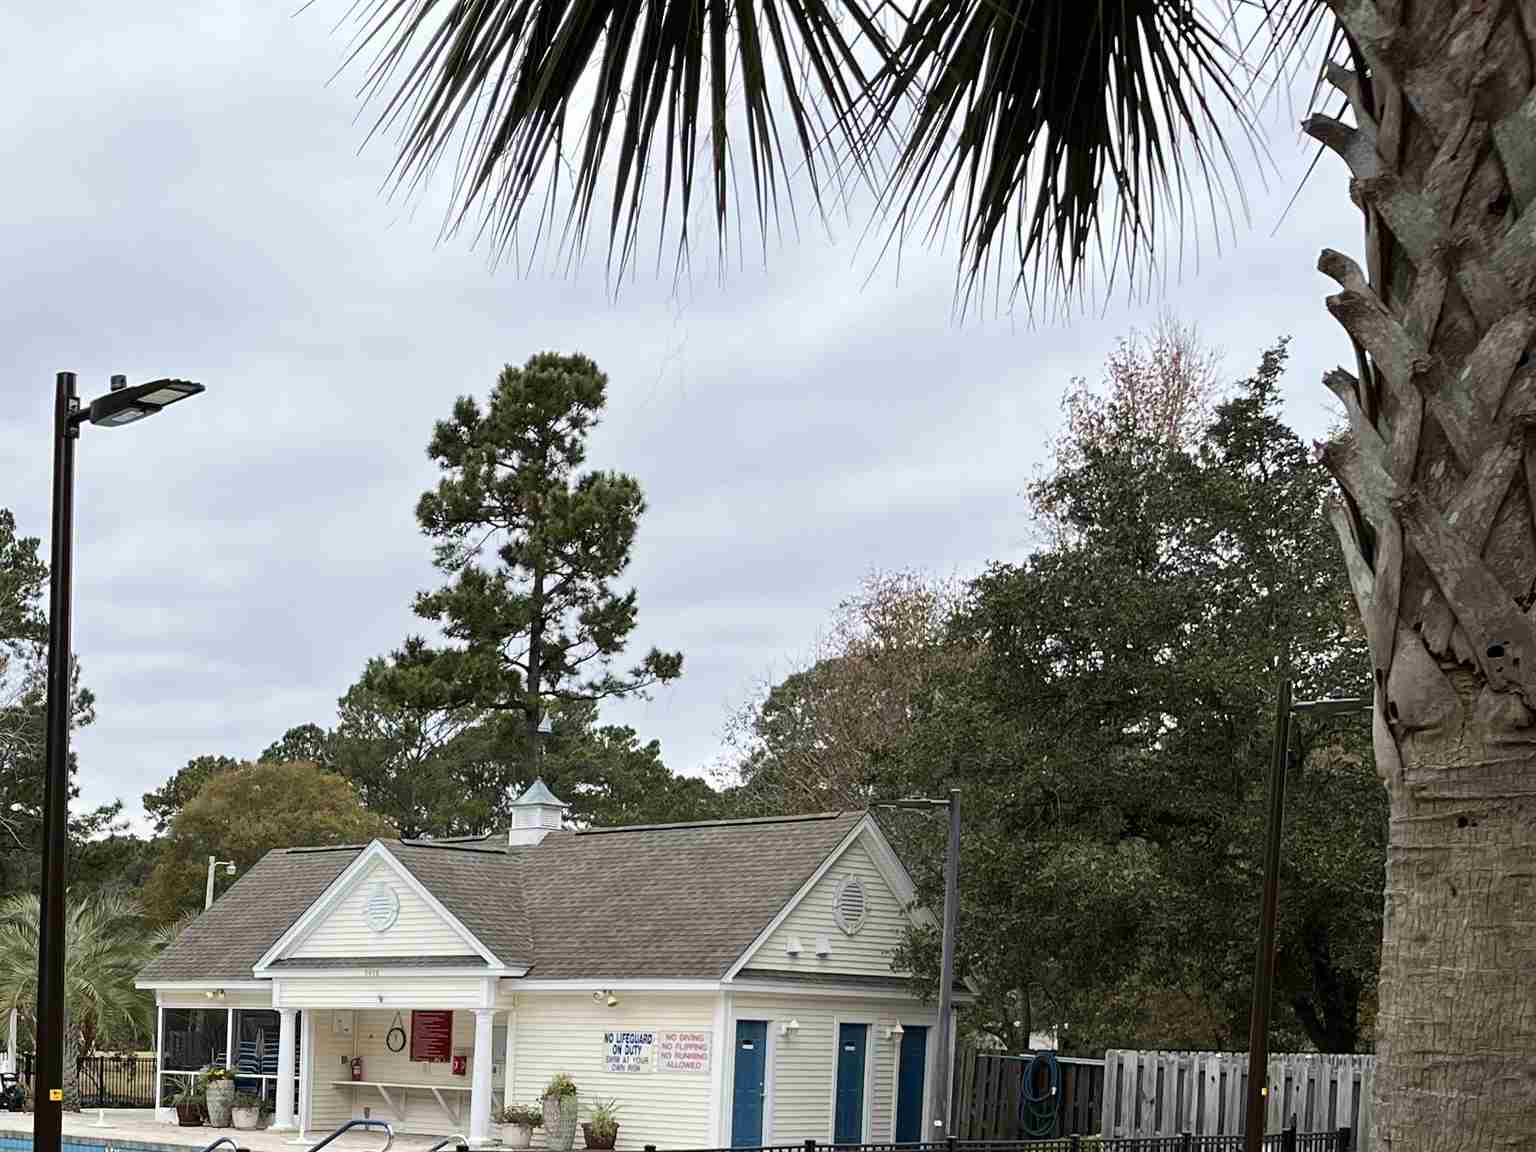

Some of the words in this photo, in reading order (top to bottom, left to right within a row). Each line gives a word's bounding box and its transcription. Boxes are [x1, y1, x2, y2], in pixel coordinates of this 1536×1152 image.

[604, 1032, 614, 1043] NO
[616, 1033, 653, 1045] LIFEGUARD
[612, 1045, 622, 1056] ON
[625, 1045, 642, 1056] DUTY
[622, 1056, 630, 1064] AT
[632, 1056, 649, 1065] YOUR
[666, 1061, 702, 1070] ALLOWED
